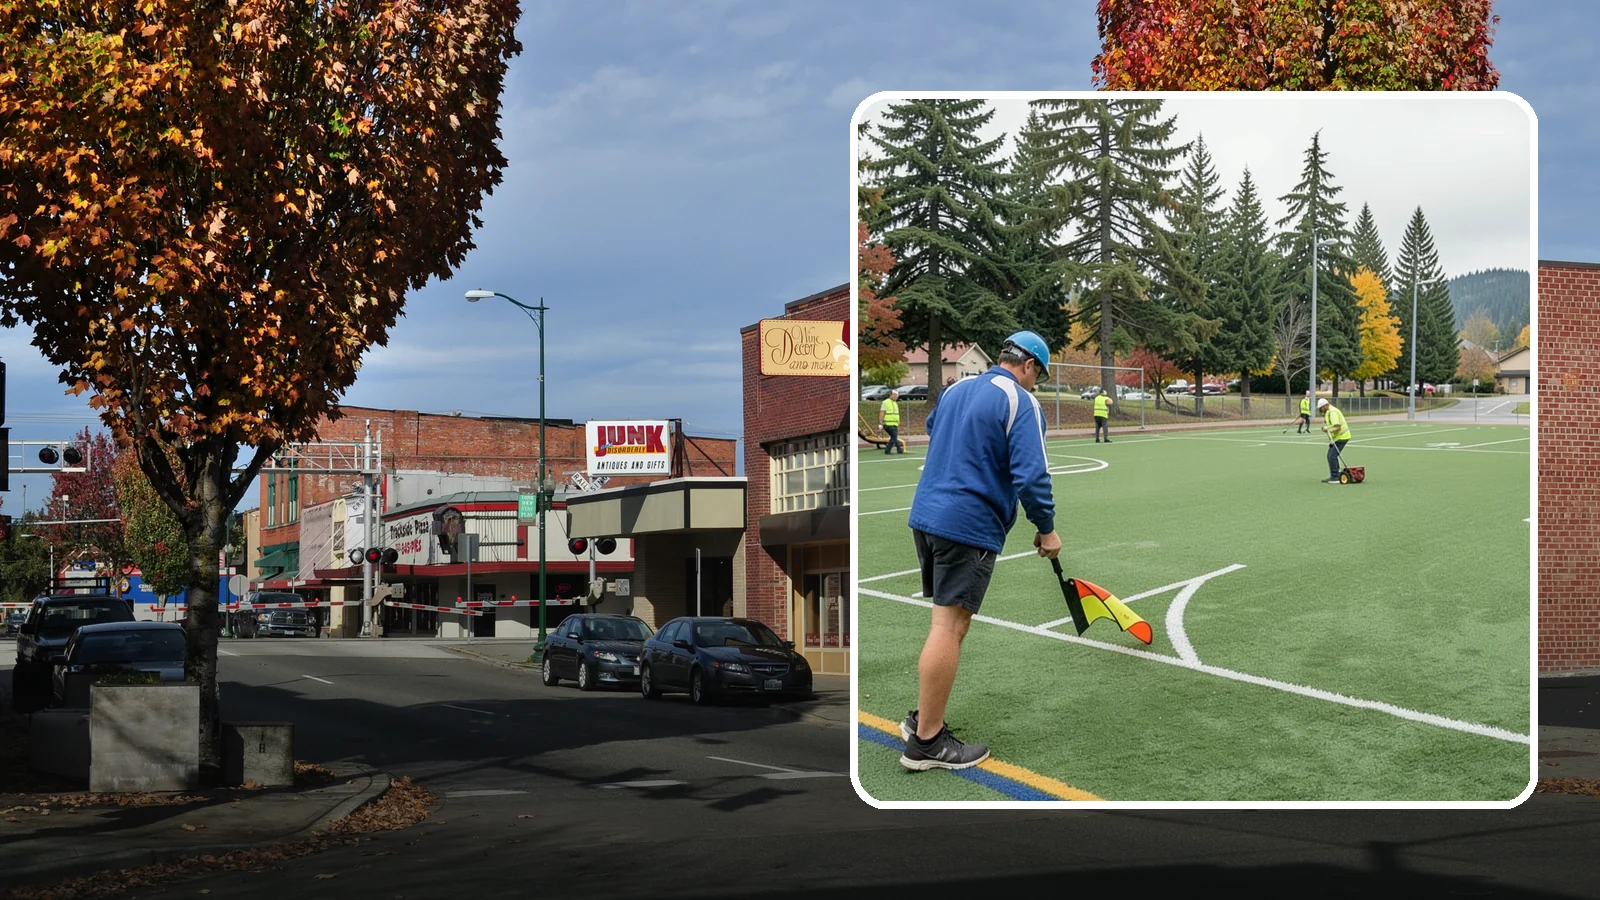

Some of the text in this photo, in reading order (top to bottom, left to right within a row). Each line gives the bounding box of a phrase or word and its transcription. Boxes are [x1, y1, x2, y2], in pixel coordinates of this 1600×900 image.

[595, 425, 665, 457] JUNK
[607, 446, 646, 454] DISORDERLY
[597, 461, 665, 470] ANTIQUES AND GIFTS
[414, 519, 429, 535] Pizza
